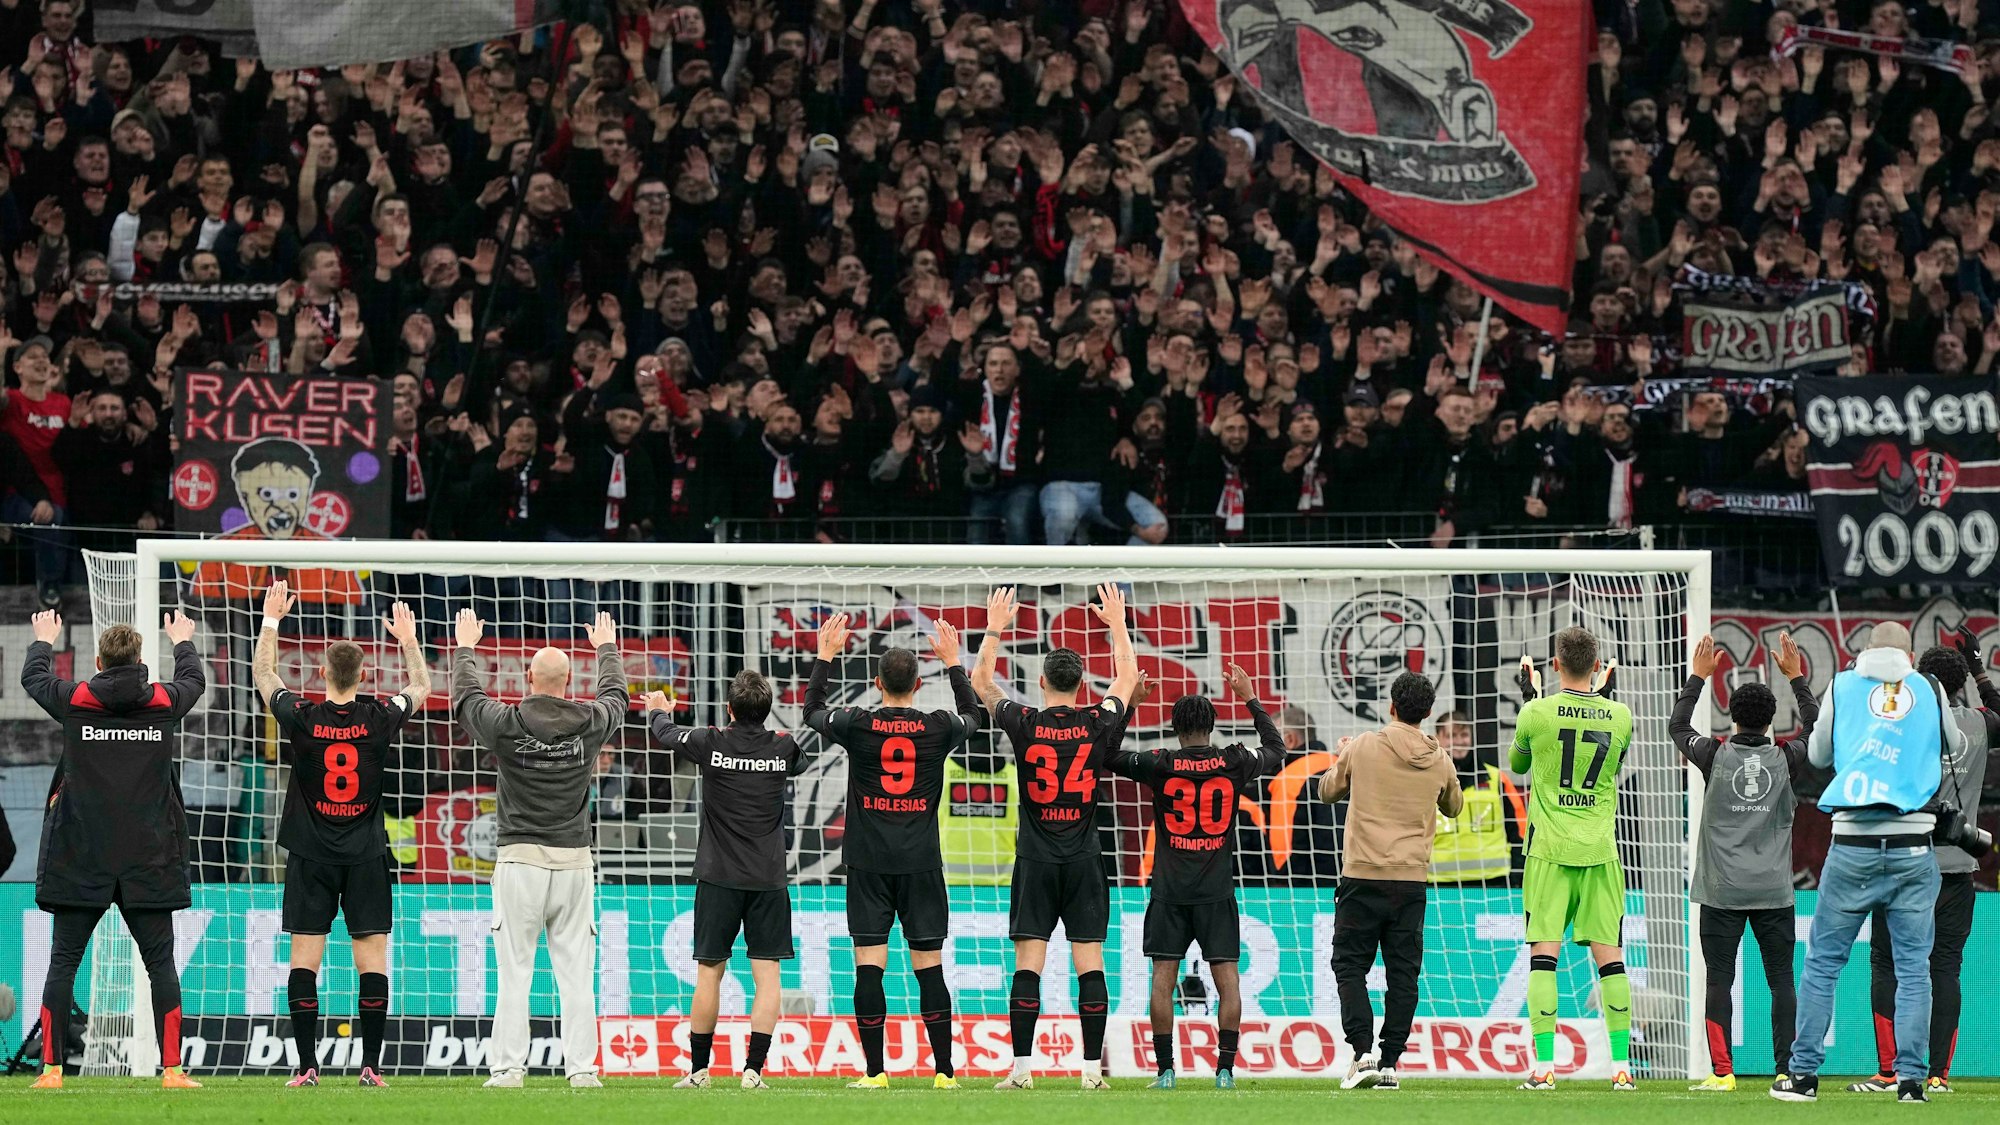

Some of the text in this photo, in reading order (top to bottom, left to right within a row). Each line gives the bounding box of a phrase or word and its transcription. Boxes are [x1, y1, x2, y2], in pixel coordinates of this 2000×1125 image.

[187, 373, 378, 414] RAVER
[186, 409, 377, 449] KUSEN
[1838, 510, 1998, 577] 2009
[82, 725, 162, 741] Barmenia
[324, 742, 360, 803] 8
[710, 750, 787, 772] Barmenia
[881, 736, 916, 795] 9
[1024, 743, 1097, 805] 34
[1558, 728, 1612, 790] 17
[1040, 808, 1081, 821] XHAKA
[1163, 776, 1235, 836] 30
[1558, 794, 1596, 807] KOVAR
[1731, 804, 1771, 813] DFB-POKAL
[426, 1025, 563, 1067] bwn
[1131, 1021, 1336, 1074] ERGO
[1396, 1022, 1587, 1075] ERGO
